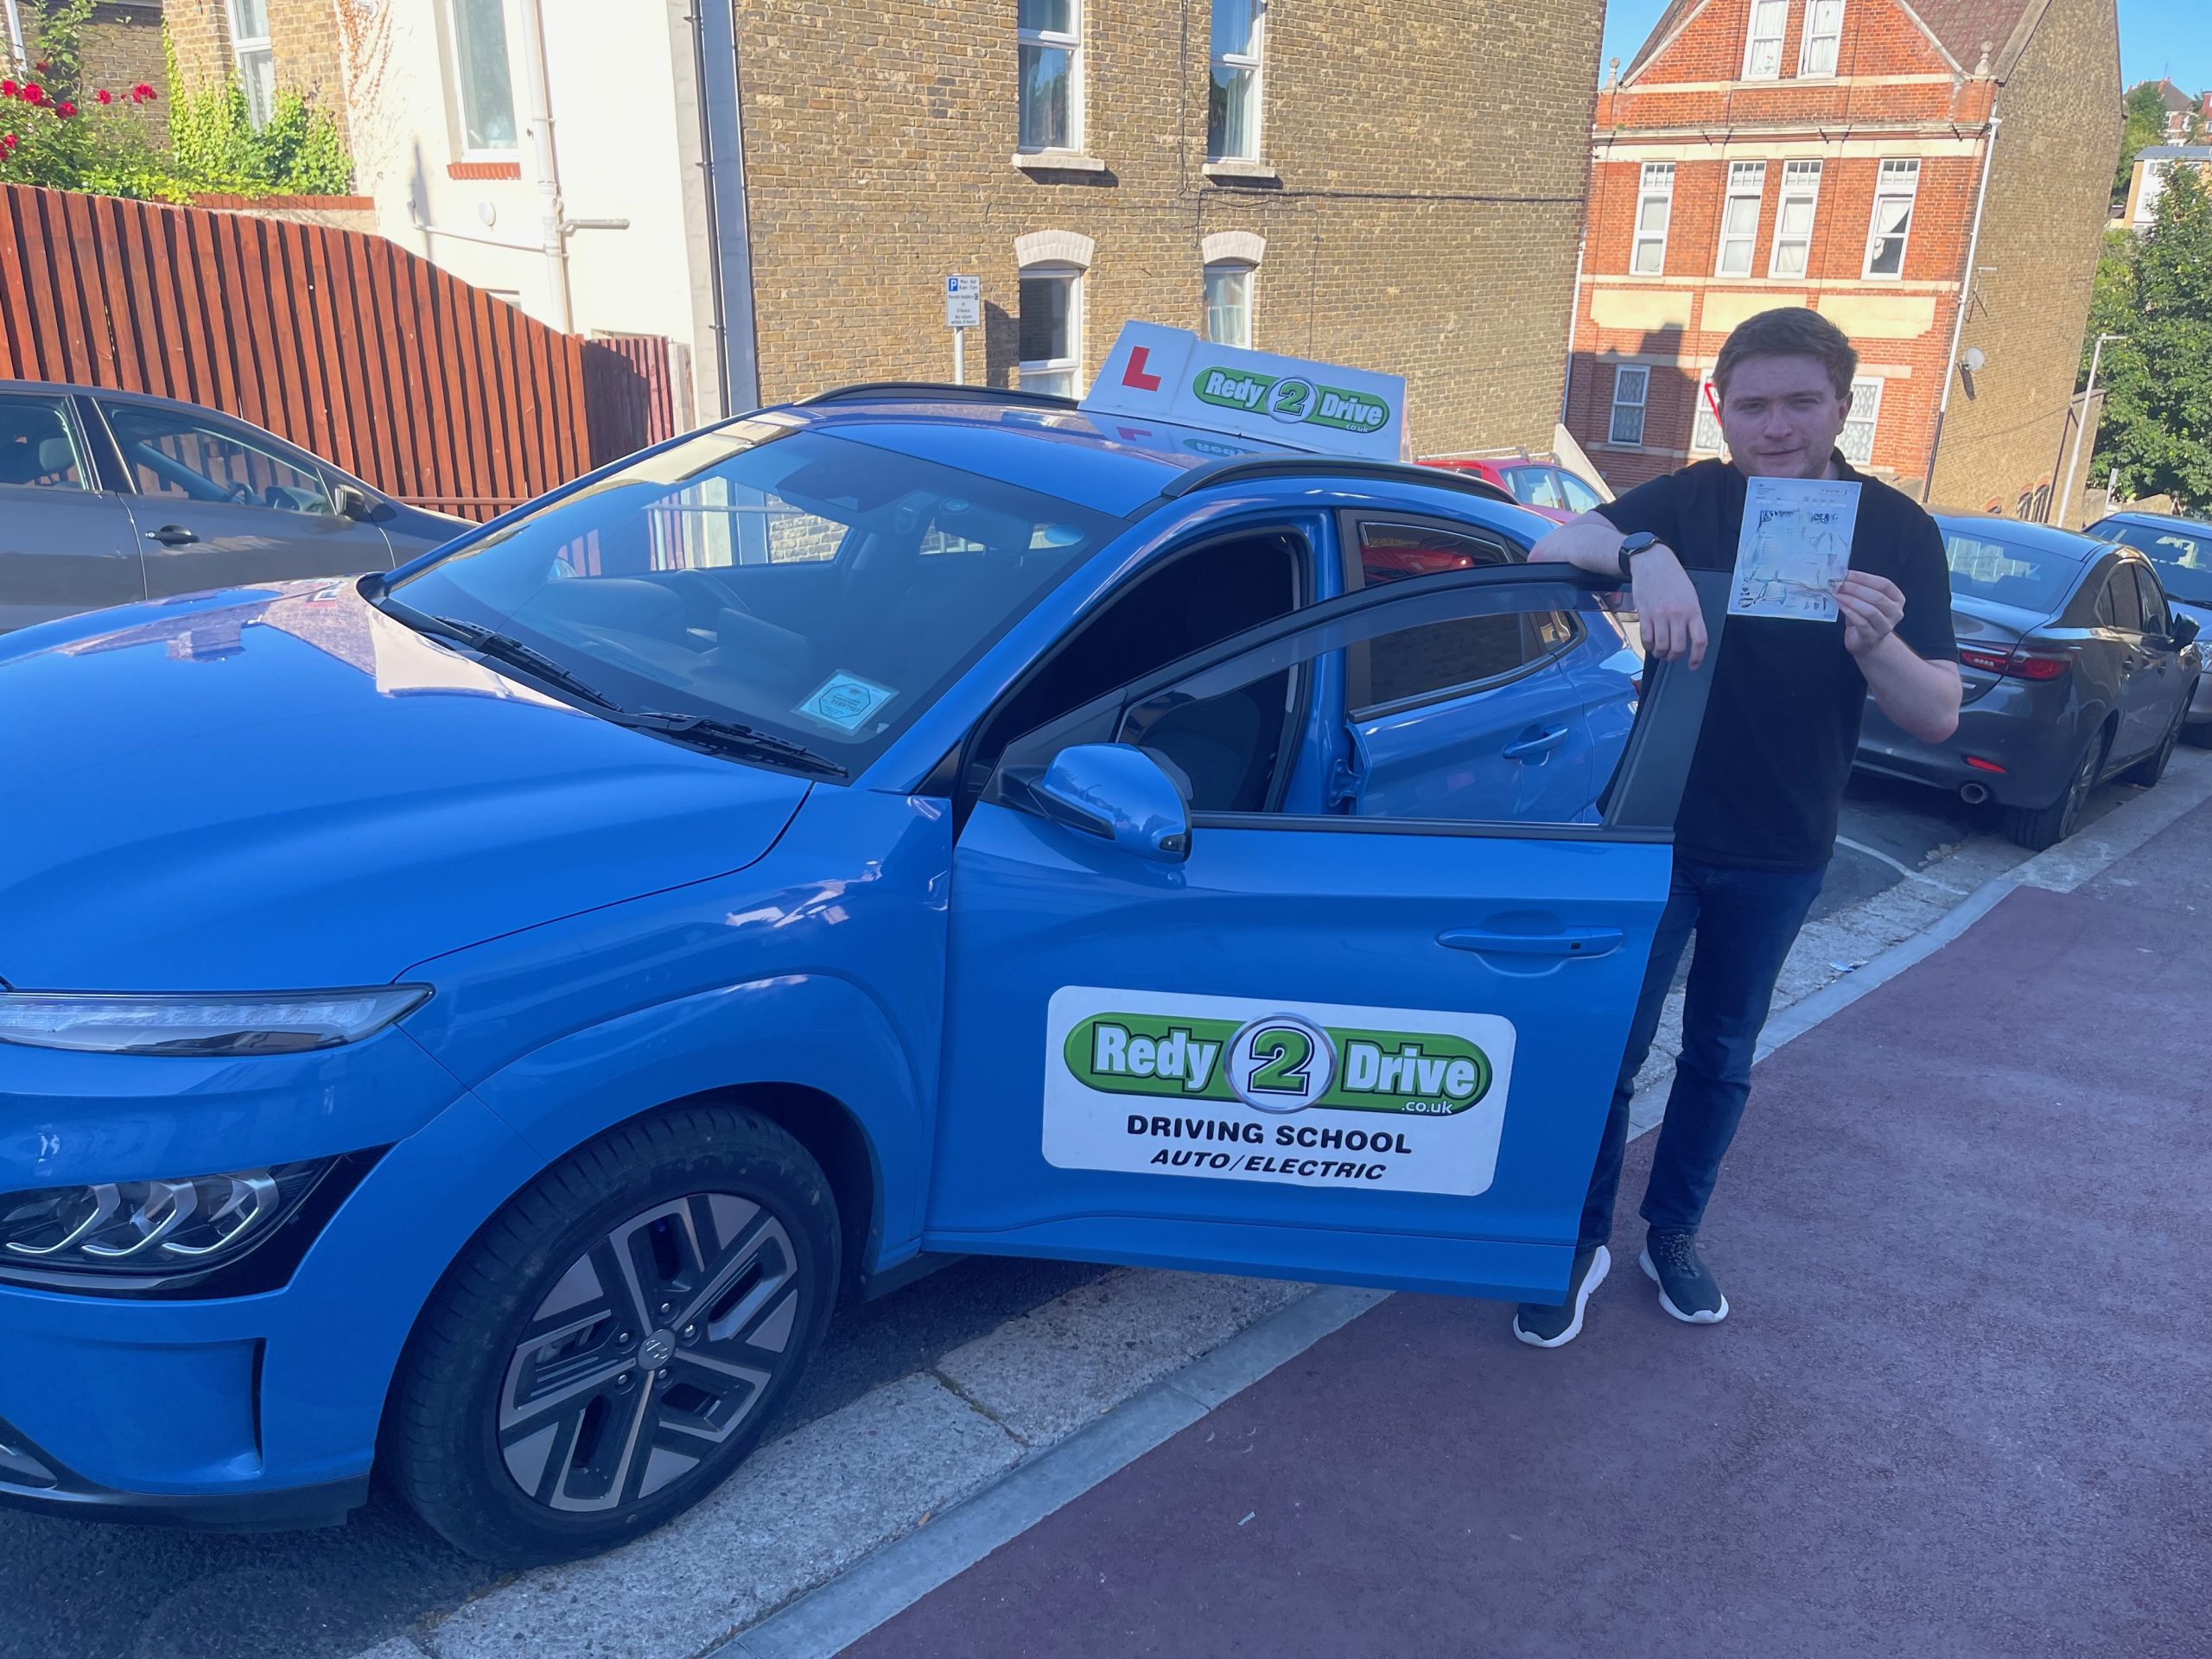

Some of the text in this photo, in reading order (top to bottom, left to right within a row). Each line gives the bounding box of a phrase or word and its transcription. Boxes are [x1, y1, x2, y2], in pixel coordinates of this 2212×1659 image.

[1122, 346, 1161, 391] L
[1207, 372, 1383, 425] Redy 2 Drive
[1094, 1022, 1476, 1097] Redy 2 Drive
[1402, 1100, 1454, 1115] .co.uk
[1127, 1115, 1413, 1154] DRIVING SCHOOL
[1150, 1148, 1388, 1180] AUTO/ELECTRIC
